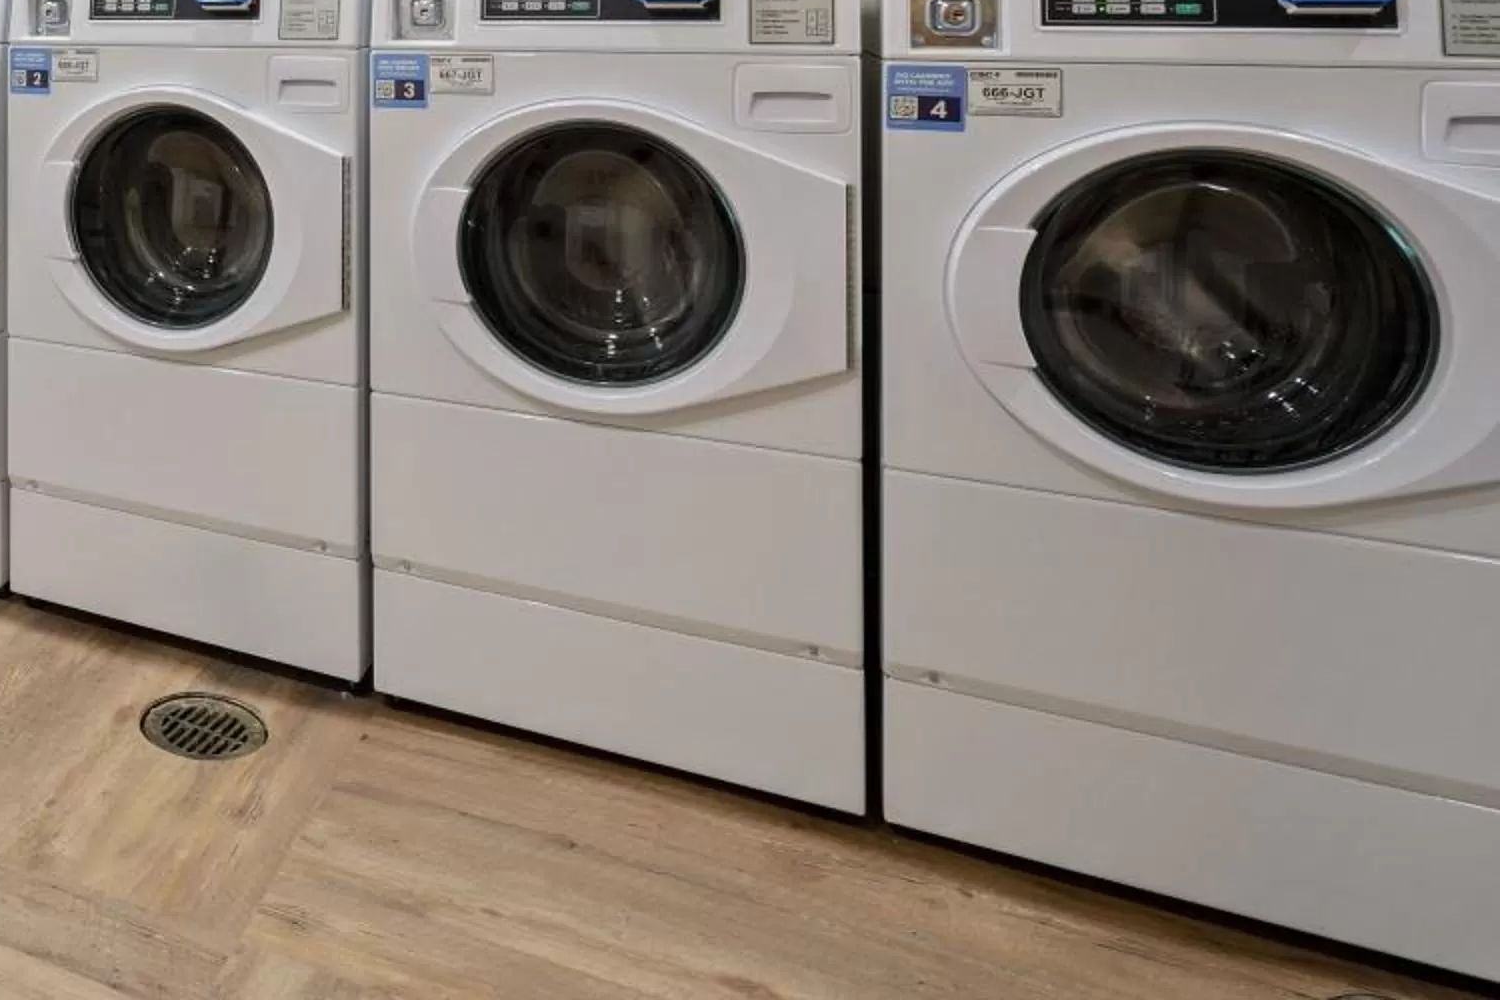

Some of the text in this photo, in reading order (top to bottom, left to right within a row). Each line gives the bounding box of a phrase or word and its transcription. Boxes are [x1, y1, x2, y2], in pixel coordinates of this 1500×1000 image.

[33, 71, 42, 86] 2
[403, 82, 415, 99] 3
[982, 87, 1046, 99] 666-JGT
[929, 100, 948, 119] 4
